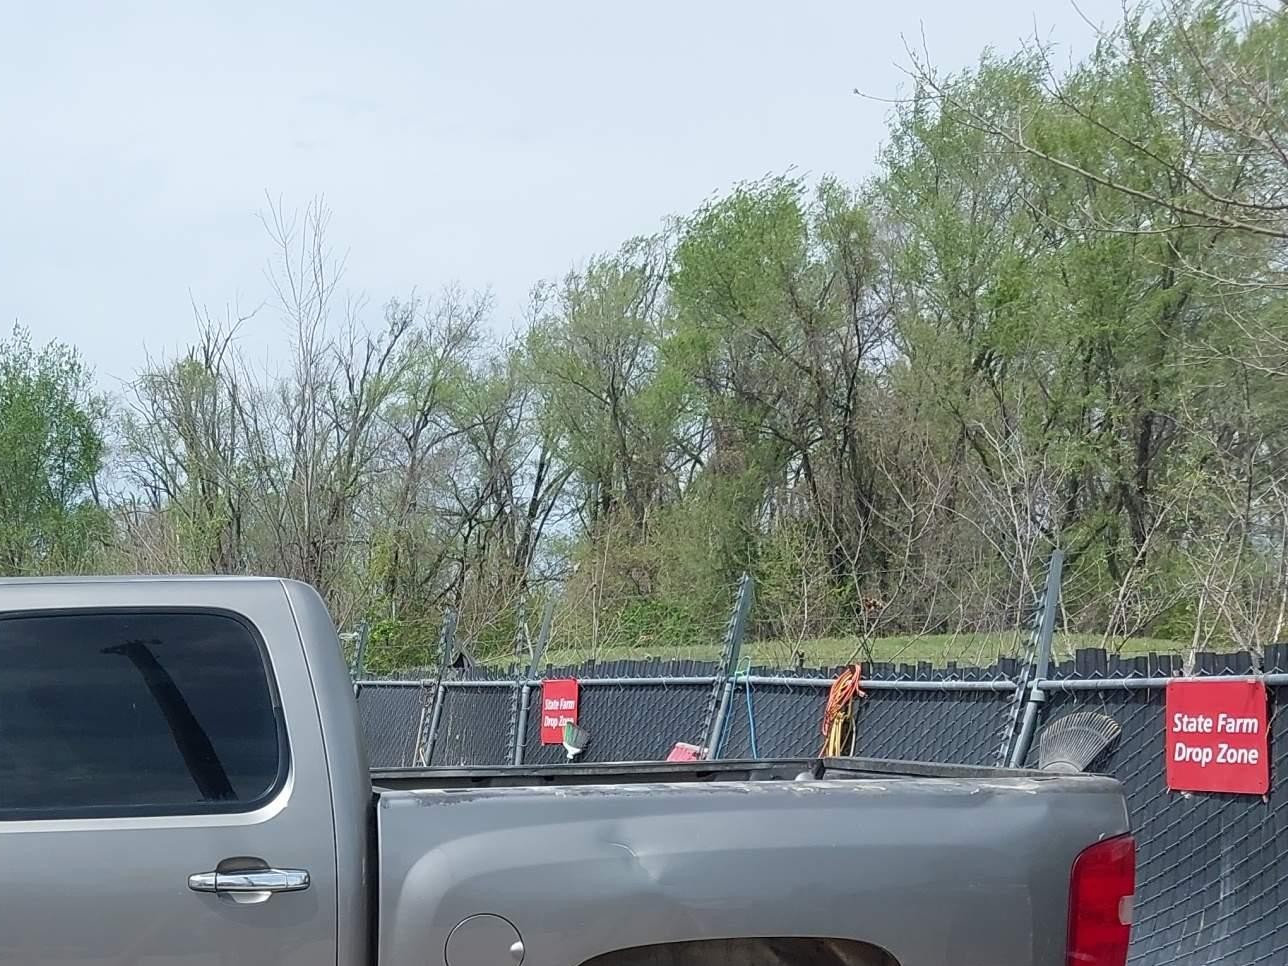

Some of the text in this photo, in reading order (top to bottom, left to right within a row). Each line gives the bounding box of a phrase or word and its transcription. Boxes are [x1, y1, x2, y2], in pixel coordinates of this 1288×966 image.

[544, 698, 575, 710] State Farm
[544, 715, 558, 730] Drop
[1173, 713, 1259, 733] State Farm
[1174, 742, 1259, 767] Drop Zone
